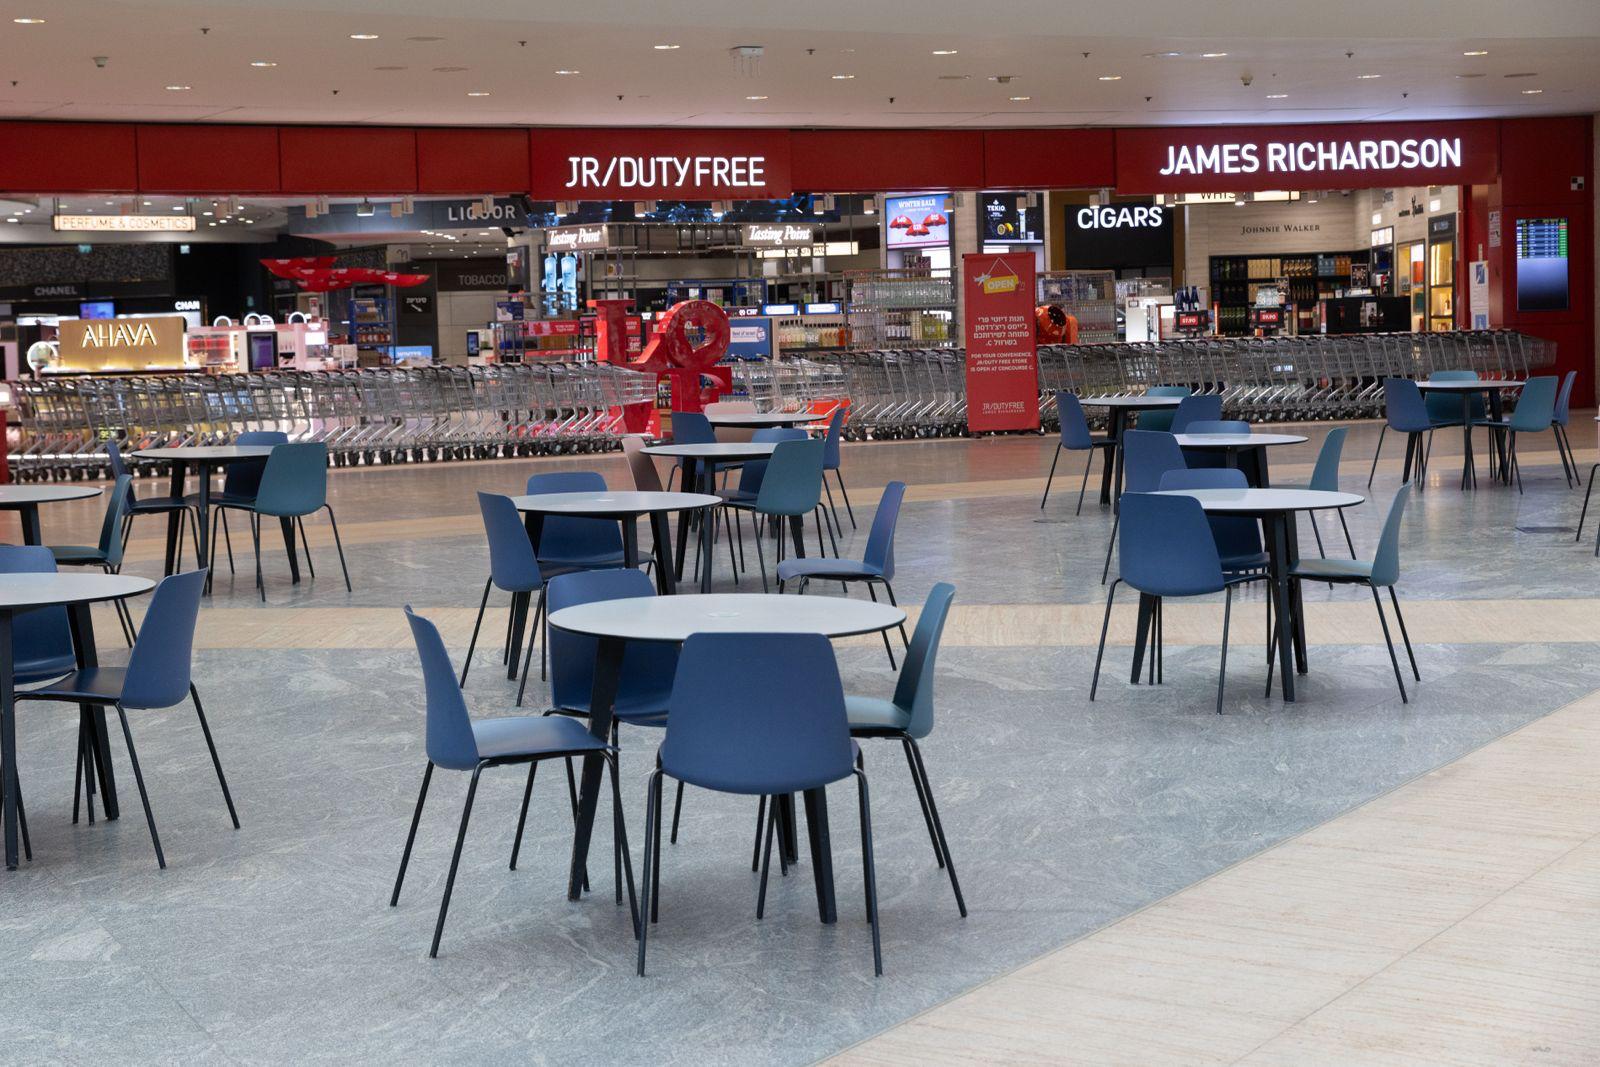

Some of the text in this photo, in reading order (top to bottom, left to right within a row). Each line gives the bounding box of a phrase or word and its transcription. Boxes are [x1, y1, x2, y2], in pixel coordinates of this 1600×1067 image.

[1159, 137, 1462, 176] JAMES RICHARDSON
[62, 217, 189, 229] PERFUME & COSMETICS
[1077, 206, 1163, 230] CIGARS
[748, 224, 812, 245] Tasting Point
[1240, 223, 1321, 235] JOHNNIE WALKER
[548, 228, 601, 248] Tasting Point
[457, 274, 506, 286] TOBACCO
[987, 278, 1015, 290] OPEN
[34, 286, 78, 297] CHANEL
[82, 323, 158, 348] AHAVA
